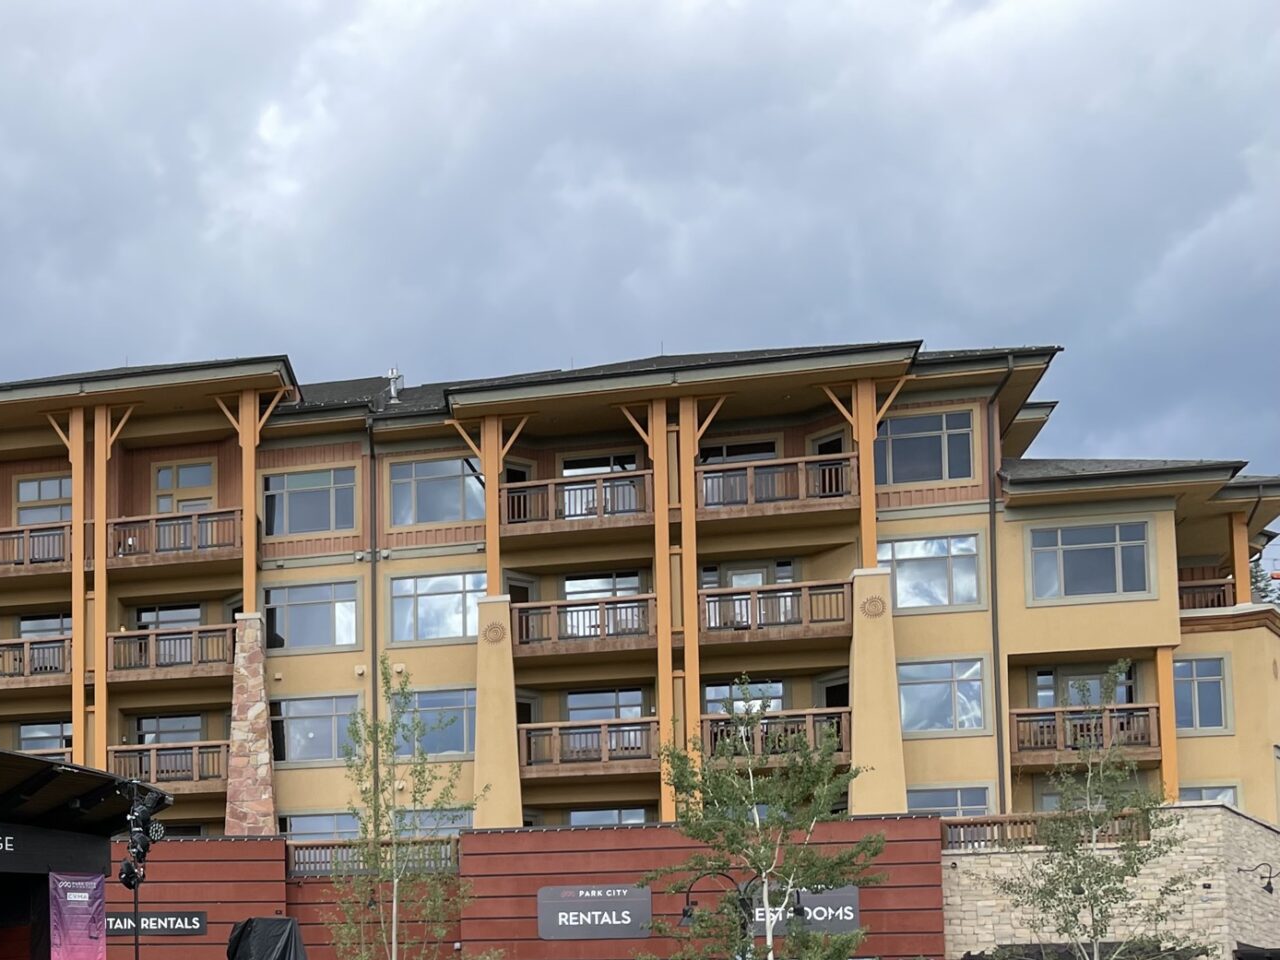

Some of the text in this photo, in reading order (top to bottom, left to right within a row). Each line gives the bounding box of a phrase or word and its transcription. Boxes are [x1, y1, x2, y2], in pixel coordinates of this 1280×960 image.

[579, 889, 602, 897] PARK
[105, 917, 200, 930] TAIN RENTALS
[558, 911, 631, 925] RENTALS
